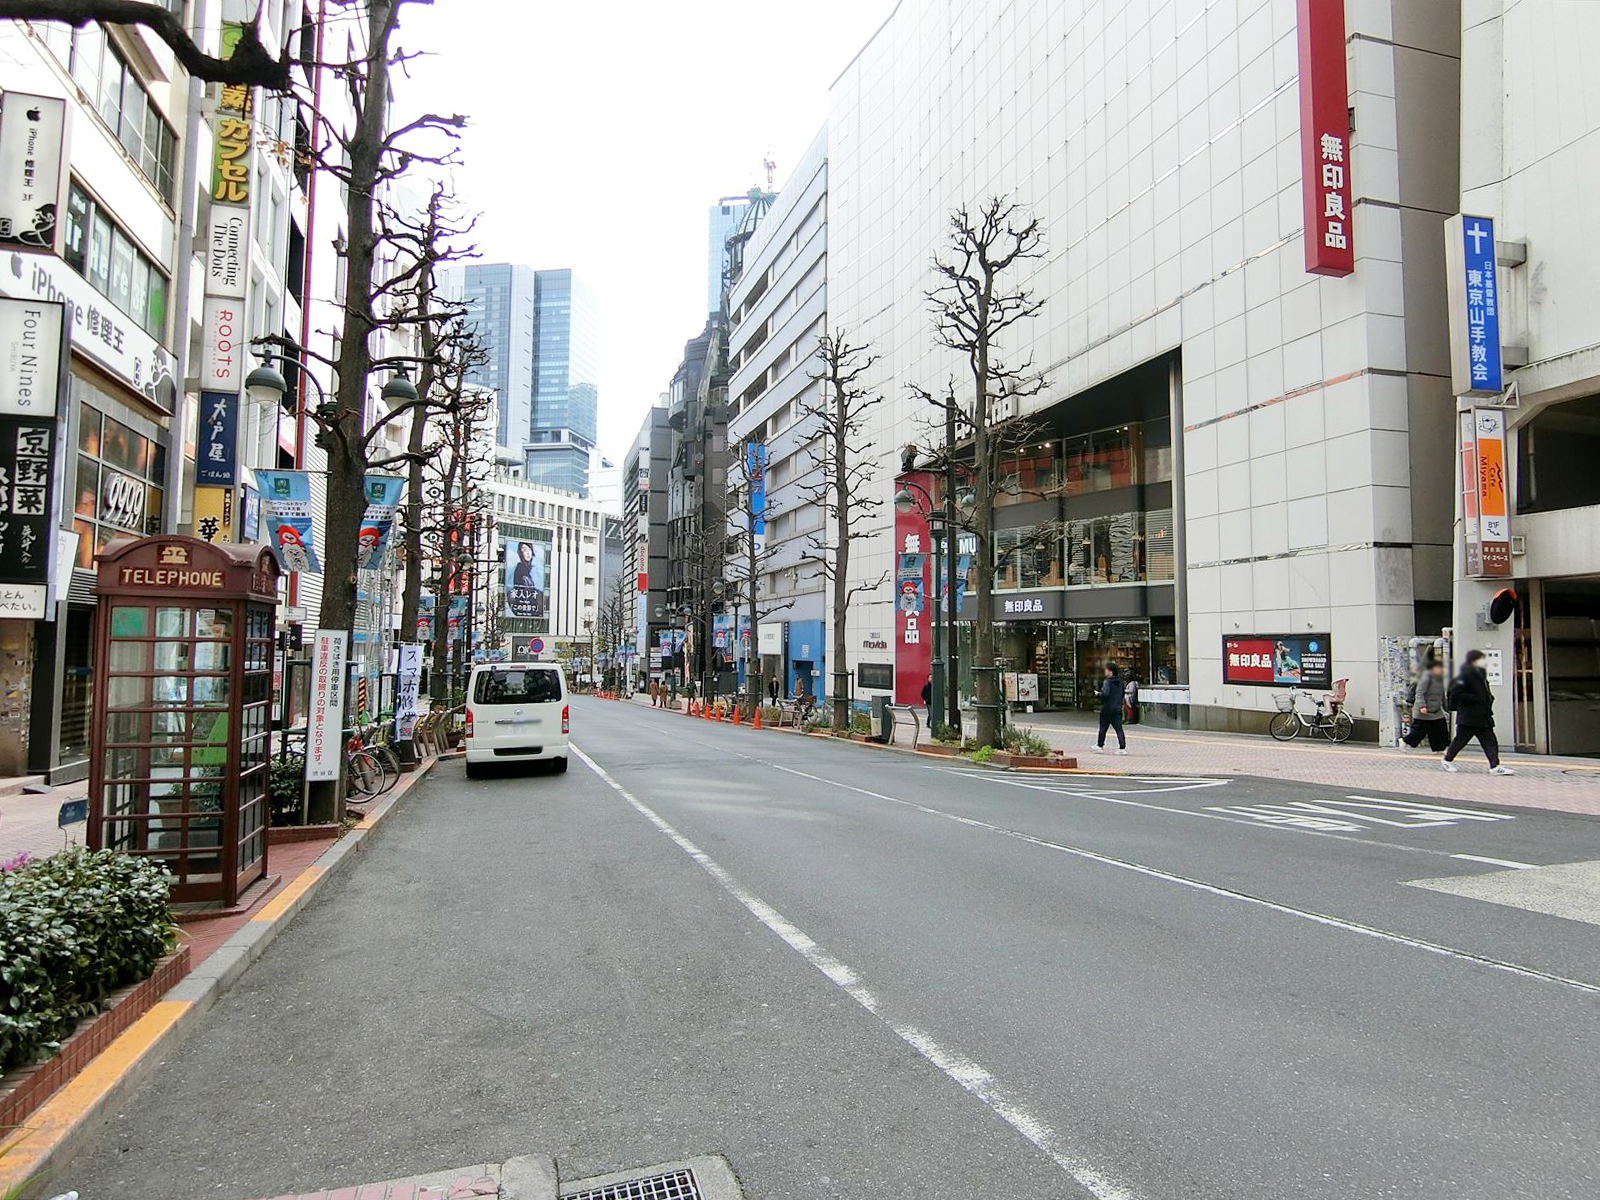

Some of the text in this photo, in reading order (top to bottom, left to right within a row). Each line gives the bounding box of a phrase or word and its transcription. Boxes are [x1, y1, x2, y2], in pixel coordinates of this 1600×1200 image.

[27, 128, 38, 156] iPhone
[215, 117, 251, 202] カプセル
[1321, 133, 1346, 250] 無印良品
[212, 223, 228, 277] The Dots
[224, 216, 243, 287] Connecting
[18, 309, 41, 407] Four Nines
[87, 304, 124, 355] 修理王
[216, 310, 233, 378] ROOTS
[1467, 269, 1488, 381] 東京山手教会
[207, 398, 228, 462] 大戸屋
[17, 429, 49, 513] 京野菜
[1488, 521, 1500, 529] B1F
[0, 590, 25, 600] とん
[122, 568, 223, 586] TELEPHONE
[511, 588, 539, 599] 家入レオ
[904, 533, 920, 643] 無品
[1004, 599, 1043, 613] 無印良品
[329, 637, 342, 707] 荷さばき用停車区間
[1229, 653, 1272, 668] 無印良品
[313, 636, 329, 766] 駐車違反の取締りの対象となります。
